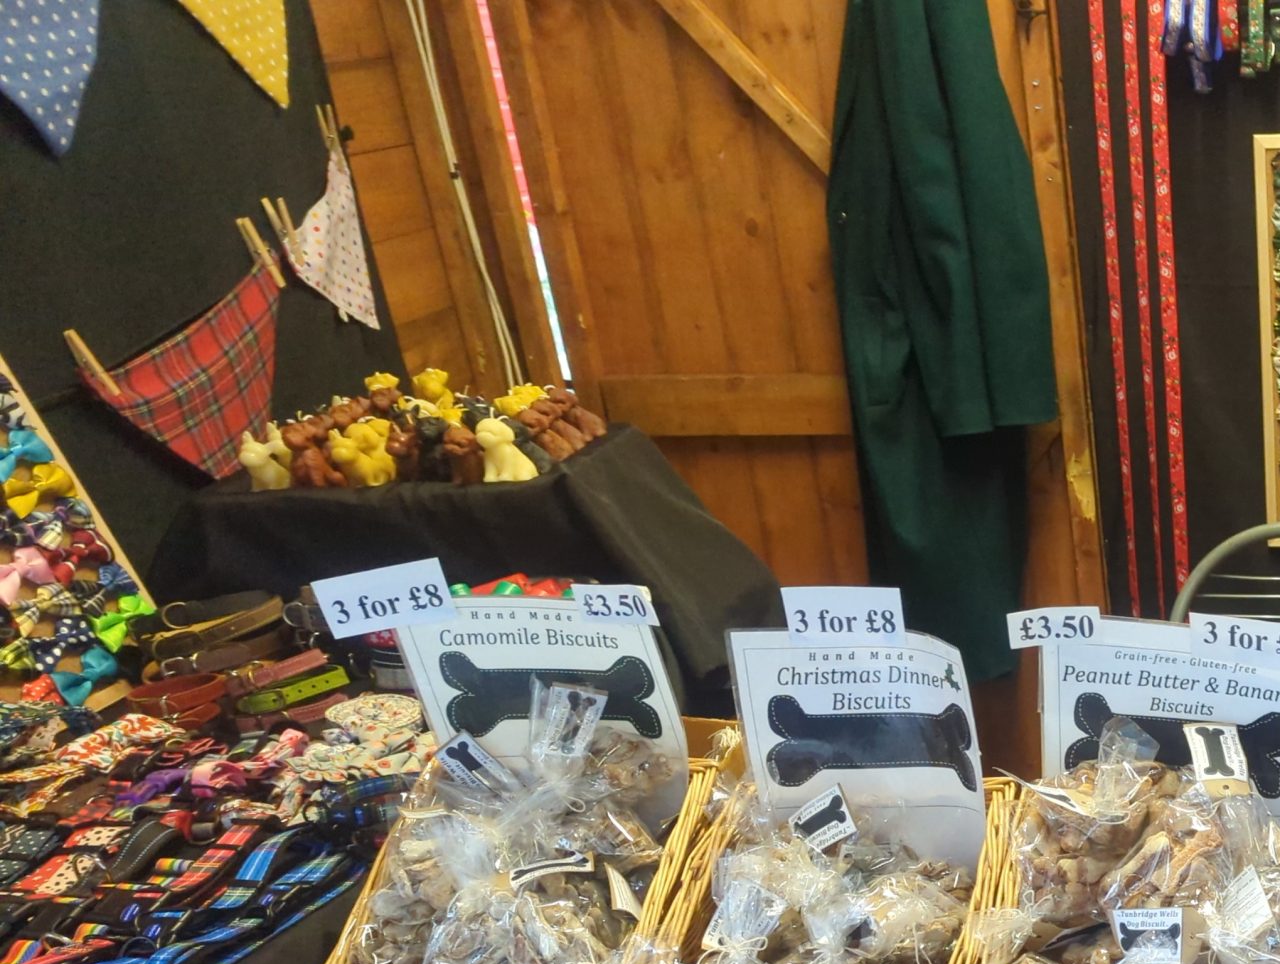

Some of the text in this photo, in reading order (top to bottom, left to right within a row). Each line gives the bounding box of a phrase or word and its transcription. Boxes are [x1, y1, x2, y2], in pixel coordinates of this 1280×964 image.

[332, 583, 444, 625] 3 for £8
[471, 610, 574, 622] Hand Made
[583, 594, 648, 618] £3.50
[793, 609, 897, 633] 3 for £8
[1019, 615, 1094, 641] £3.50
[439, 627, 619, 650] Camomile Biscuits
[1203, 621, 1218, 644] 3
[1228, 625, 1268, 651] for
[809, 651, 914, 661] Hand Made
[1115, 650, 1177, 665] Grain-free
[1189, 657, 1257, 675] Gluten-free
[777, 665, 946, 690] Christmas Dinner
[1062, 664, 1131, 686] Peanut
[1137, 670, 1200, 692] Butter
[1204, 676, 1220, 694] &
[832, 692, 912, 711] Biscuits
[1150, 697, 1215, 717] Biscuits
